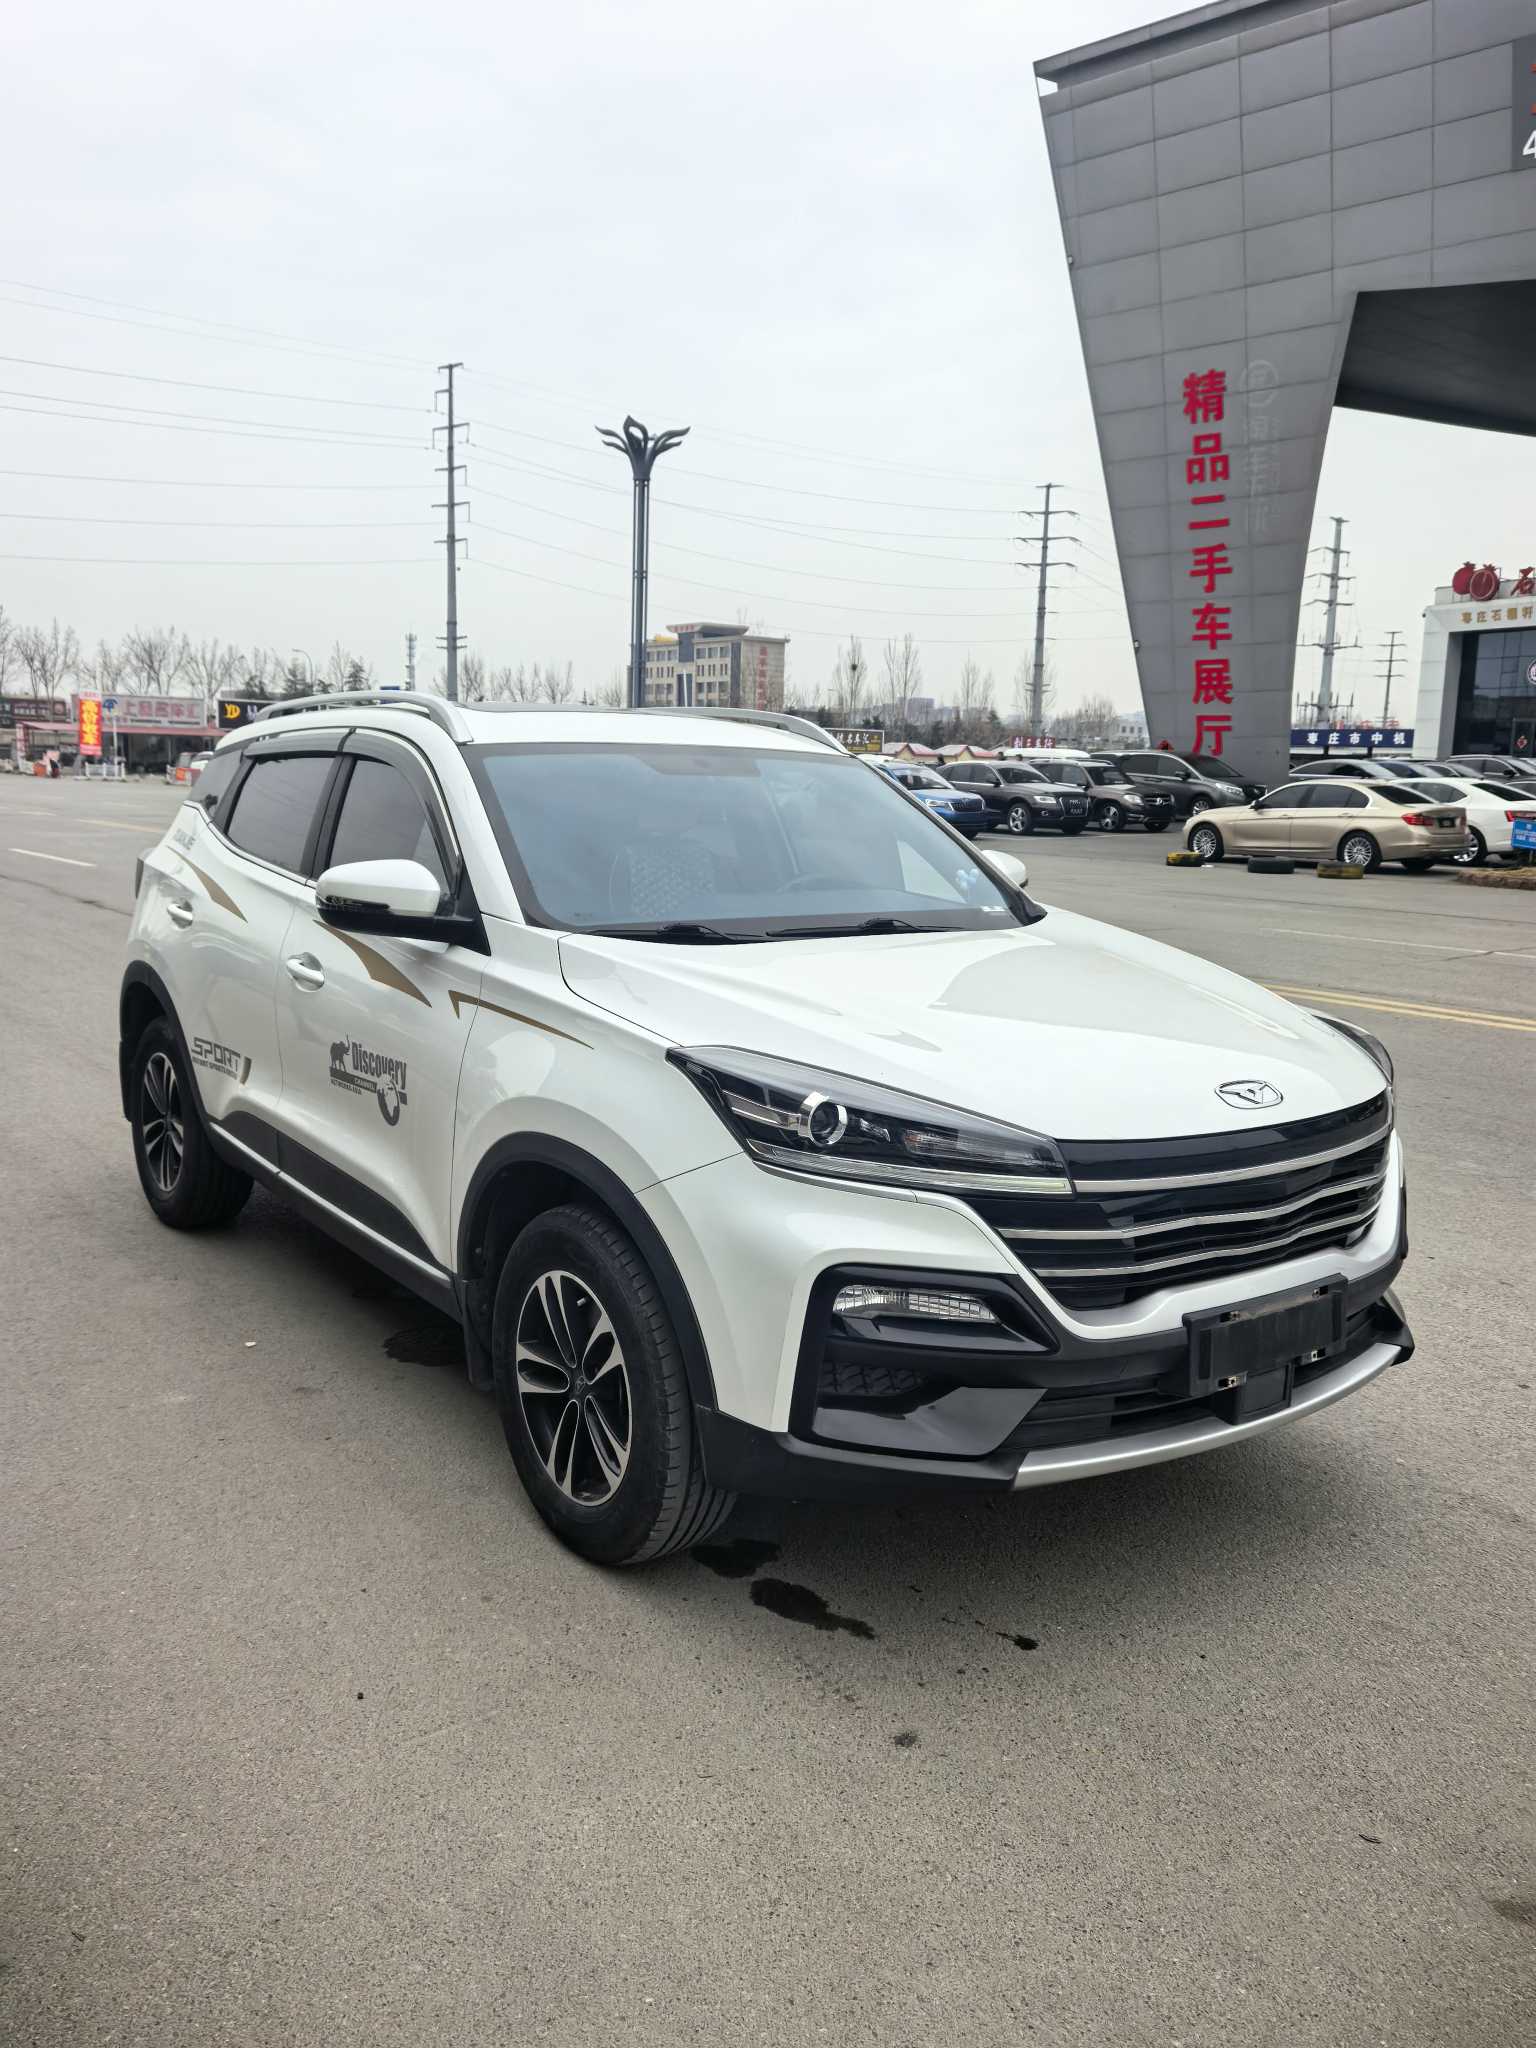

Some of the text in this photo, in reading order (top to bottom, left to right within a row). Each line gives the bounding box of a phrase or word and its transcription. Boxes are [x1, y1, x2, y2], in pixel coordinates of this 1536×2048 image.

[1182, 368, 1234, 757] 精品二手车展厅
[191, 1036, 241, 1072] SPORT
